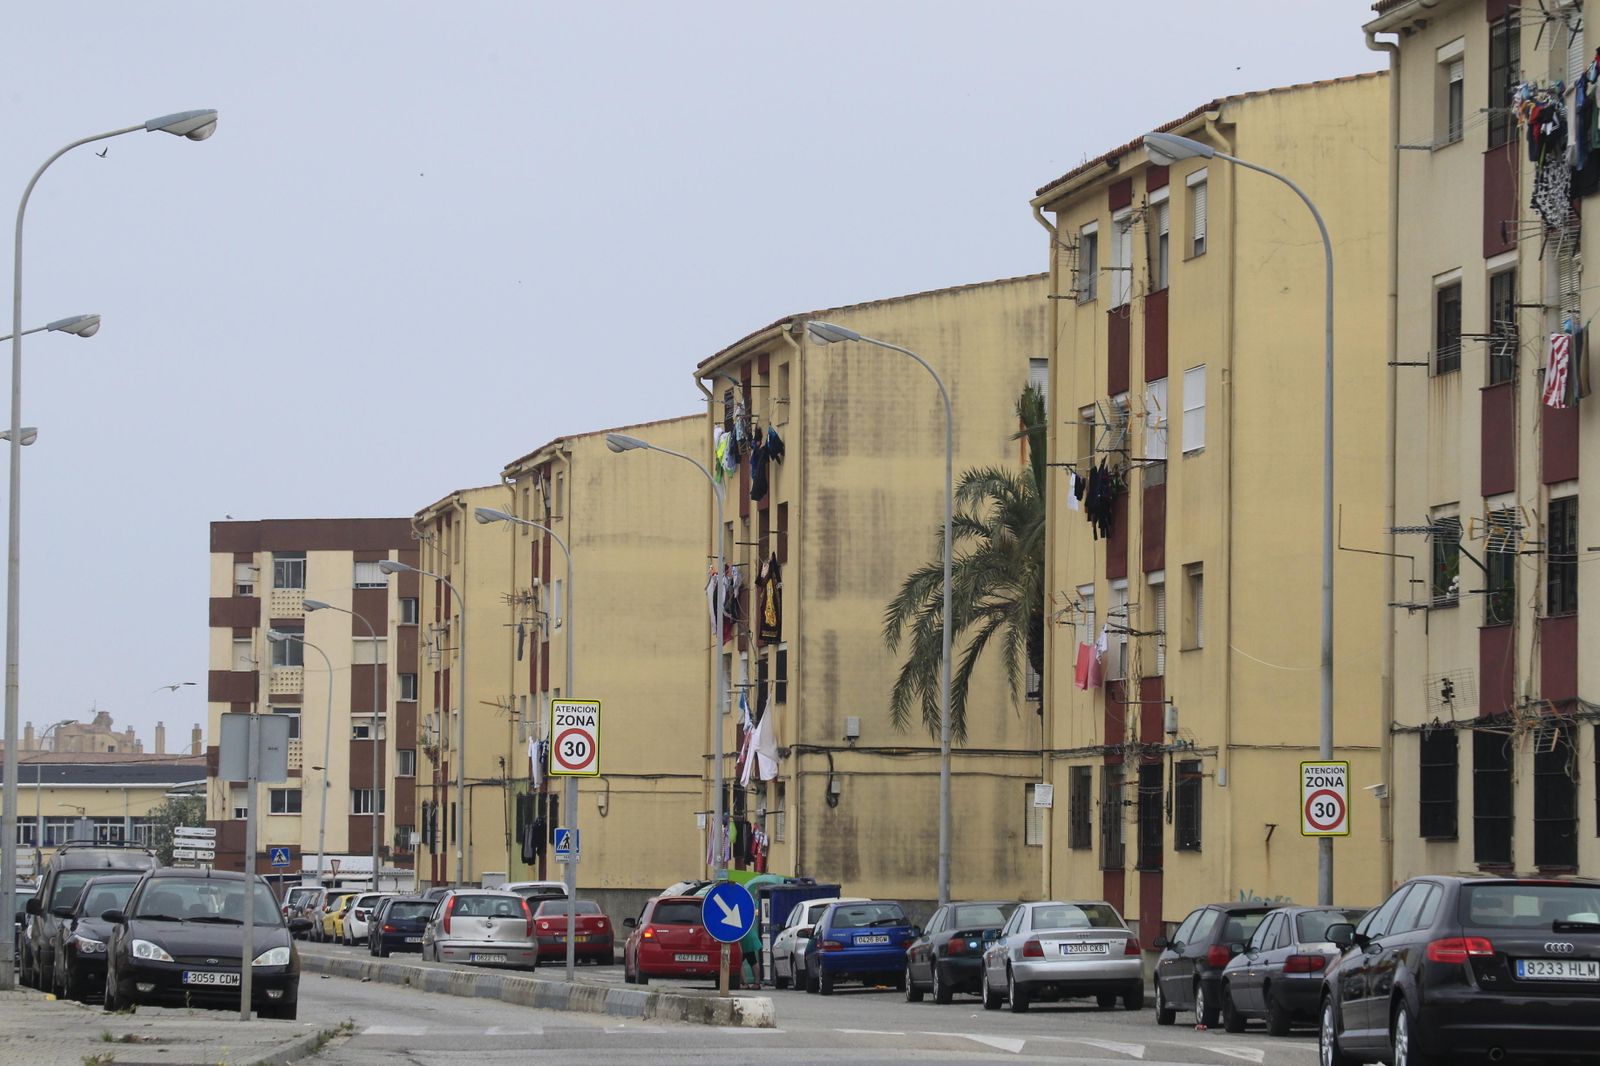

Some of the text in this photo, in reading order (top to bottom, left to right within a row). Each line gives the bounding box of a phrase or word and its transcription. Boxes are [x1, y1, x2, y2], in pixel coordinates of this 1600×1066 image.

[555, 705, 597, 714] ATENCIÓN
[556, 715, 595, 726] ZONA
[564, 741, 586, 757] 30
[1305, 766, 1345, 774] ATENCIÓN
[1306, 776, 1344, 787] ZONA
[1315, 802, 1336, 818] 30
[1527, 962, 1596, 977] 8233 HLM
[191, 973, 239, 985] 3059 CDM
